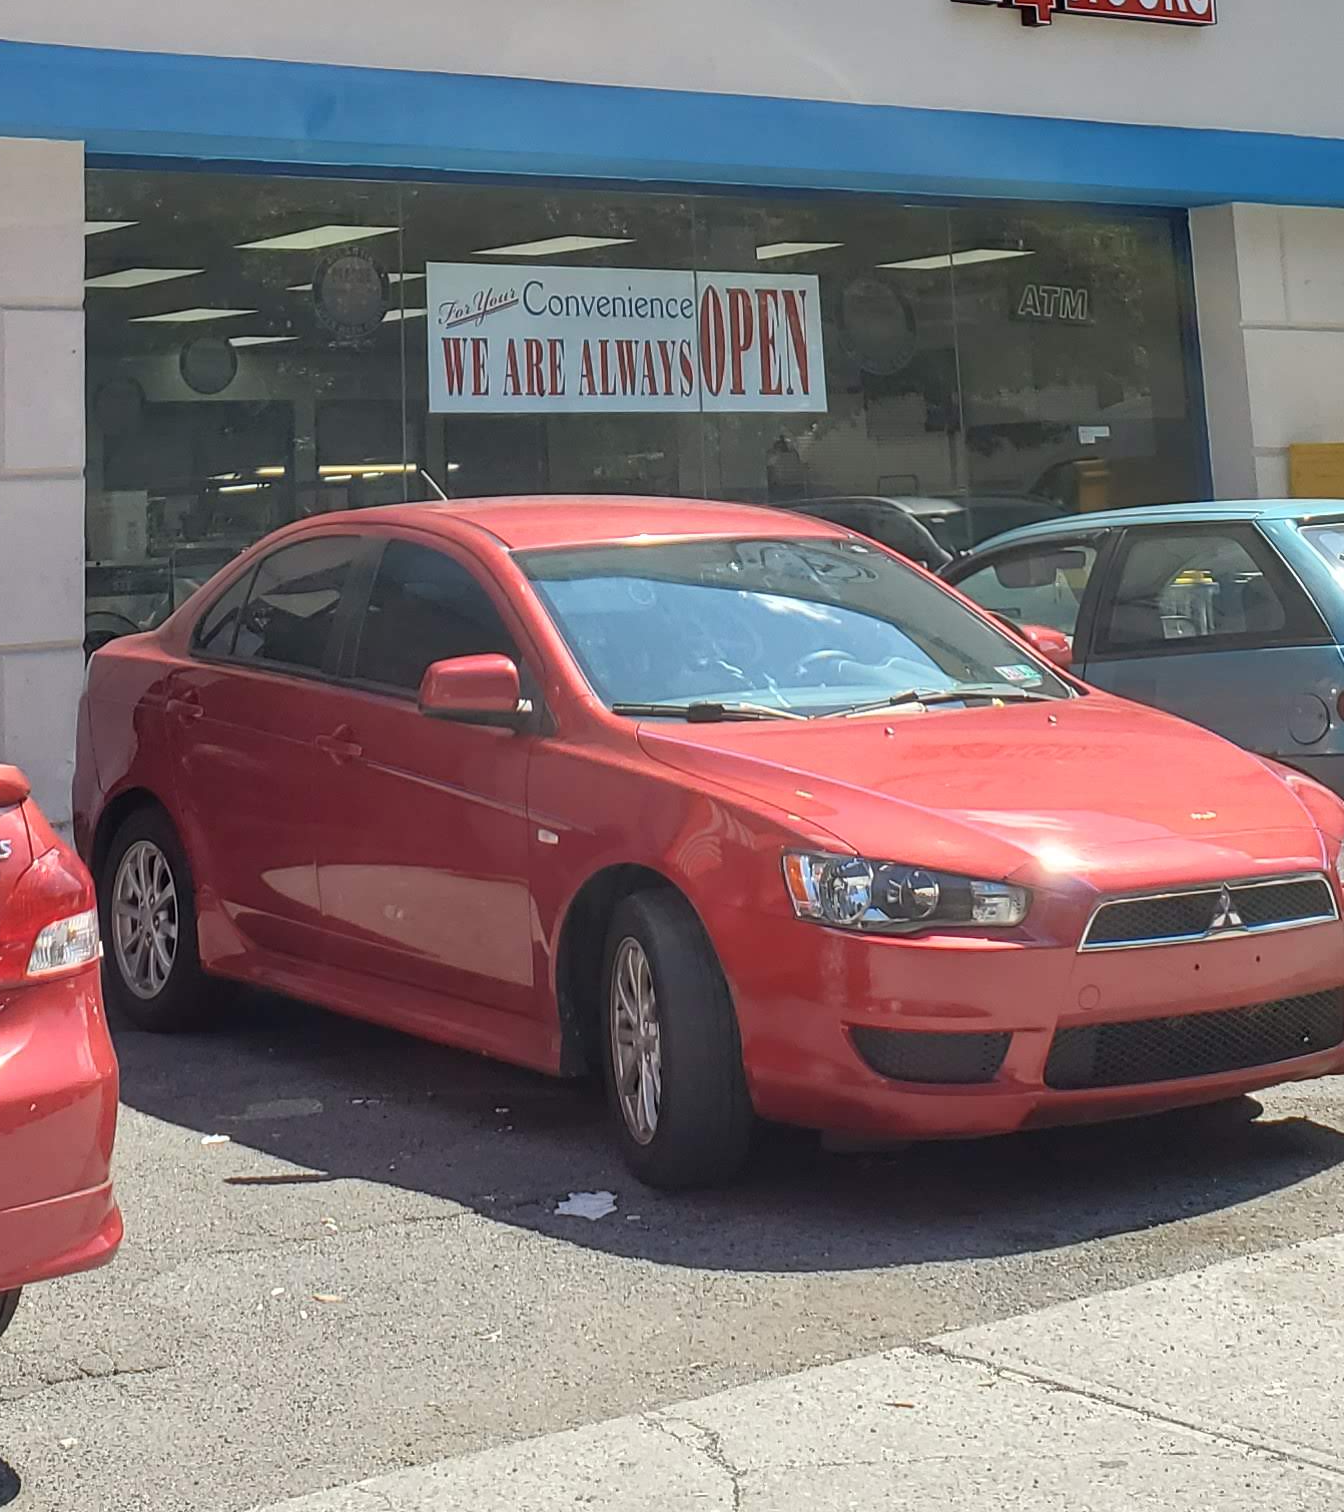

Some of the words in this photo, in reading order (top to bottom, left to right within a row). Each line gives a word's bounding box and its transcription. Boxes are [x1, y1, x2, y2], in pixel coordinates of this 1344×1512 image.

[438, 300, 470, 325] For
[471, 287, 518, 325] Your
[523, 280, 693, 318] Convenience
[1018, 284, 1087, 320] ATM
[441, 337, 489, 396] WE
[504, 339, 565, 396] ARE
[578, 339, 694, 397] ALWAYS
[699, 285, 810, 396] OPEN
